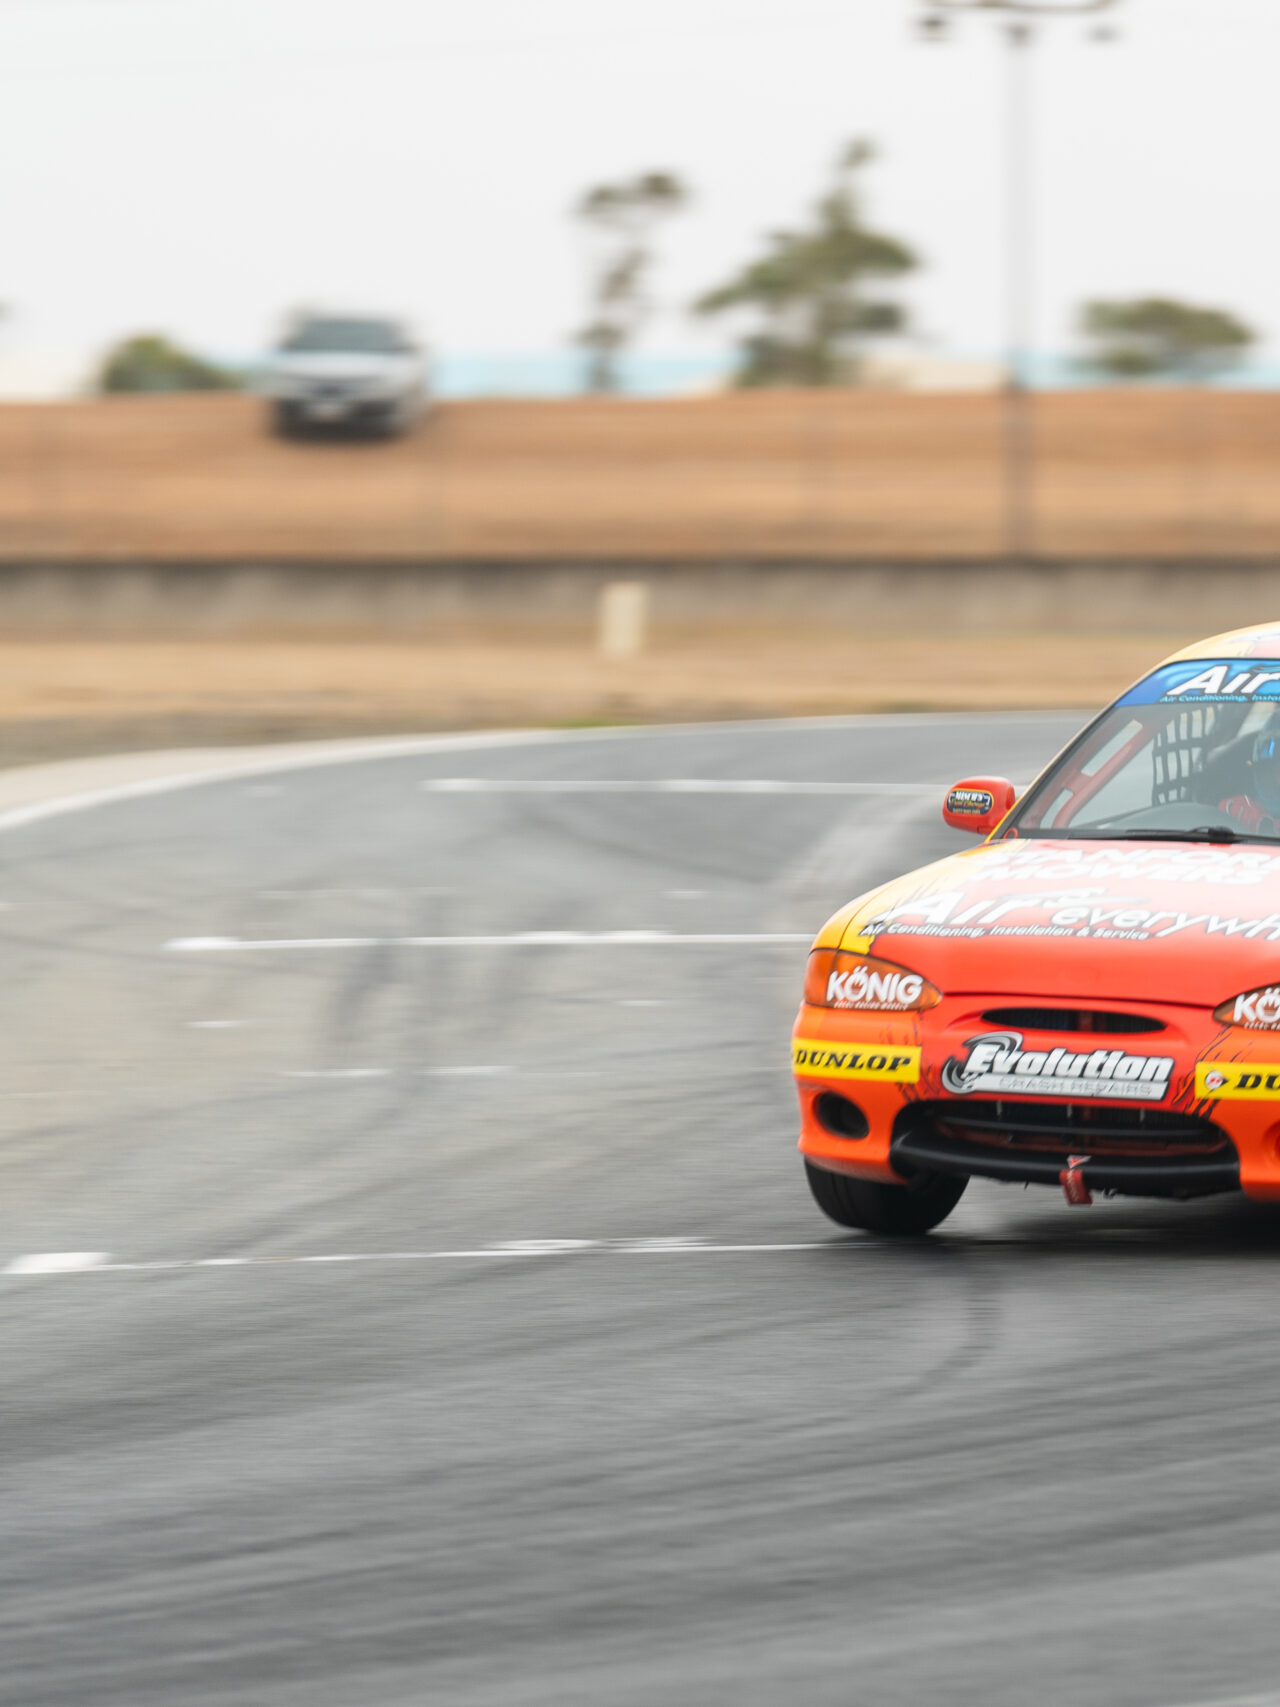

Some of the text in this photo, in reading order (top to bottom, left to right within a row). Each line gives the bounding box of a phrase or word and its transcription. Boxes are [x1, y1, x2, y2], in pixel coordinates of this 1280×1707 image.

[967, 863, 1269, 885] MOWERS
[872, 892, 1040, 925] Air
[860, 923, 884, 936] Air
[989, 923, 1074, 937] Installation
[1076, 925, 1091, 937] &
[1092, 926, 1150, 941] Service
[826, 965, 924, 1005] KÖNIG
[796, 1048, 911, 1071] DUNLOP
[964, 1043, 1175, 1082] Evolution
